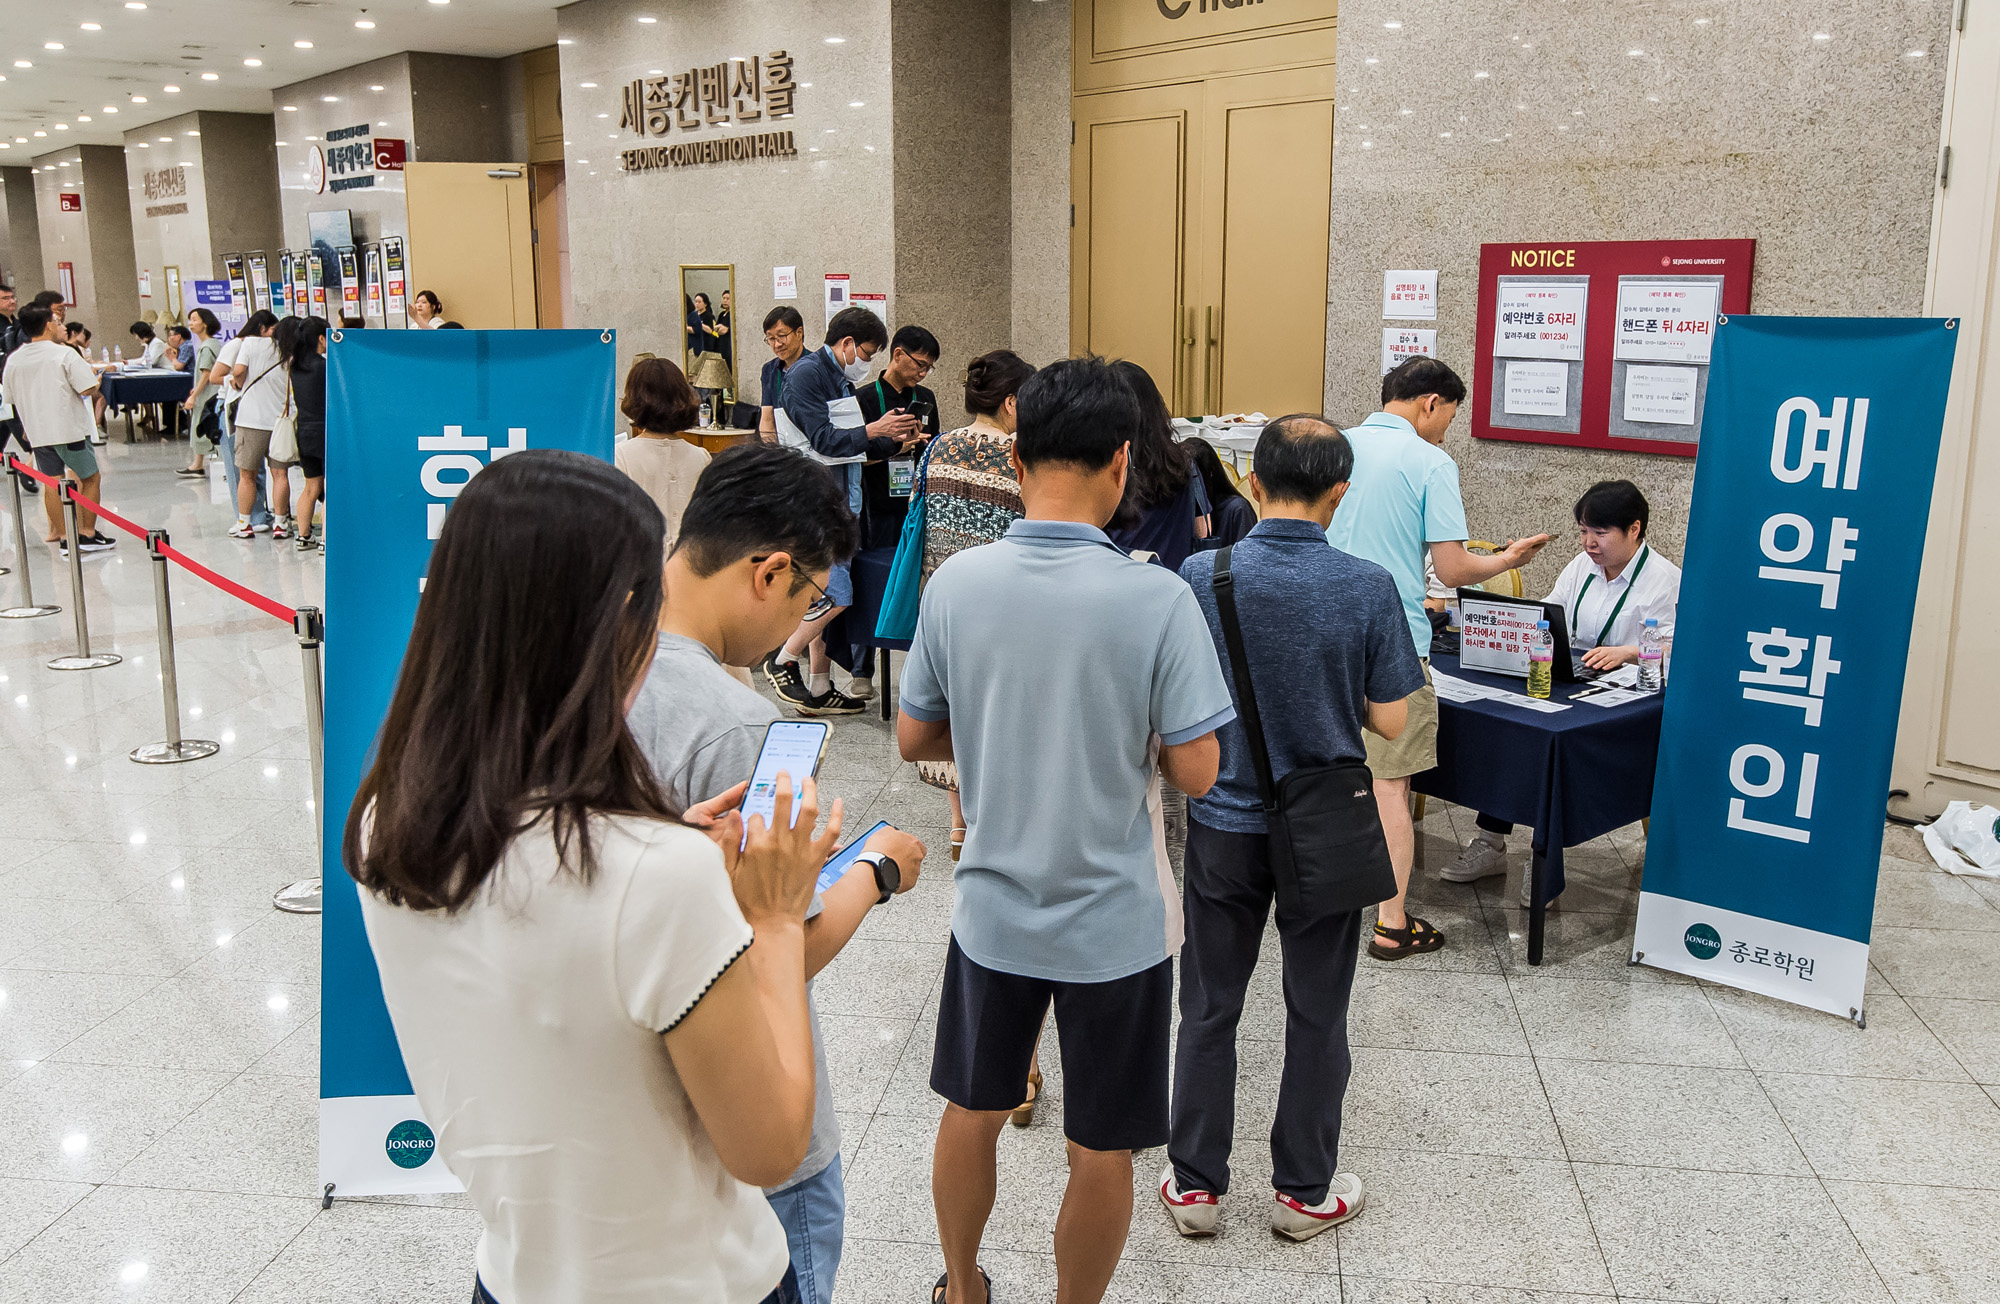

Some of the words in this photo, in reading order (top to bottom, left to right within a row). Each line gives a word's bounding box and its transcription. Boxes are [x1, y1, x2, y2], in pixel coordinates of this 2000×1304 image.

[618, 50, 797, 135] 세종컨벤션홀
[621, 147, 668, 171] SEJONG
[668, 135, 755, 167] CONVENTION
[757, 131, 797, 157] HALL
[377, 152, 390, 168] C
[62, 200, 71, 210] B
[1510, 249, 1576, 268] NOTICE
[1418, 293, 1430, 301] 금지
[1502, 311, 1545, 325] 예약번호
[1547, 312, 1576, 326] 6자리
[1622, 318, 1658, 333] 핸드폰
[1662, 320, 1674, 334] 뒤
[1676, 320, 1710, 335] 4자리
[1504, 331, 1537, 340] 알려주세요
[1539, 332, 1569, 341] (001234)
[892, 476, 912, 484] STAFF
[1726, 396, 1870, 844] 예약확인
[1464, 625, 1497, 639] 문자에서
[1501, 630, 1518, 642] 미리
[1465, 638, 1486, 649] 하시면
[1489, 641, 1503, 651] 빠른
[1506, 643, 1520, 653] 입장
[1685, 933, 1721, 949] JONGRO
[1728, 940, 1816, 982] 종로학원
[387, 1139, 434, 1151] JONGRO
[1279, 1194, 1292, 1204] NIKE
